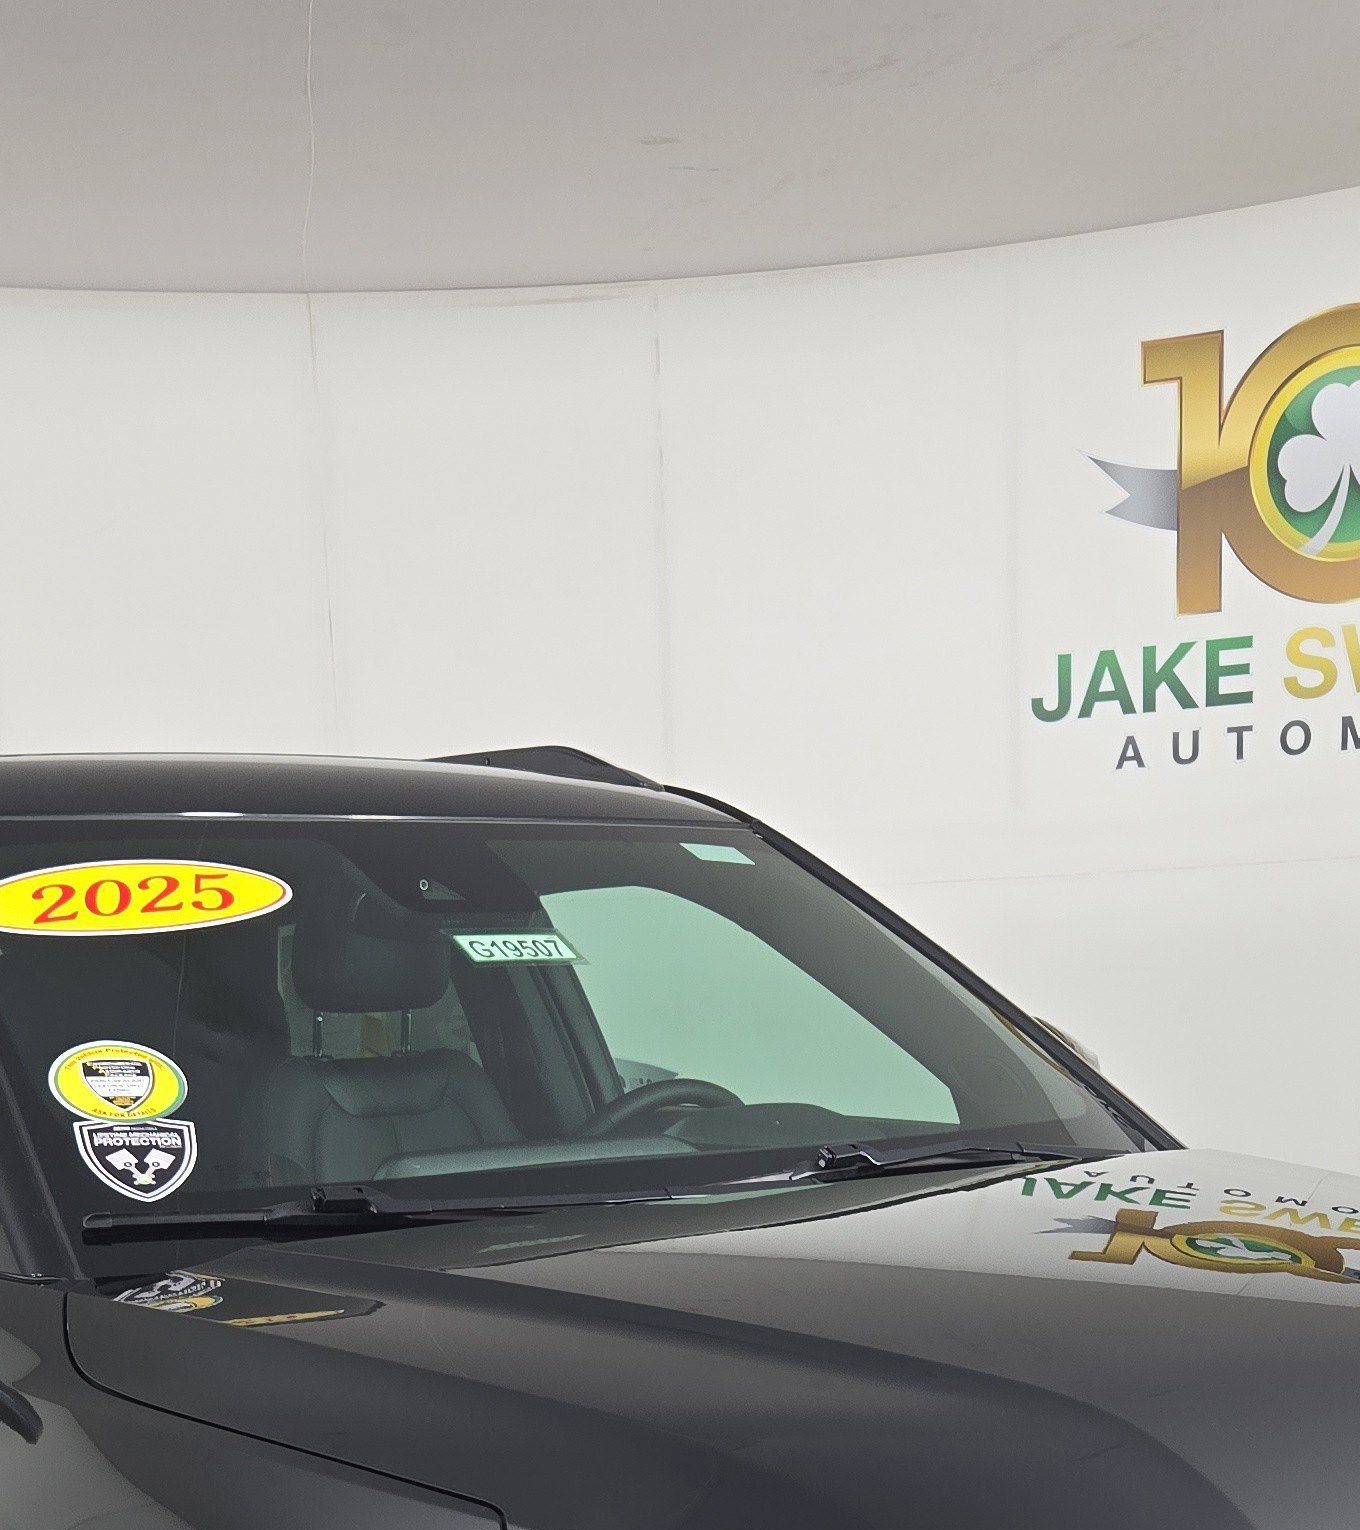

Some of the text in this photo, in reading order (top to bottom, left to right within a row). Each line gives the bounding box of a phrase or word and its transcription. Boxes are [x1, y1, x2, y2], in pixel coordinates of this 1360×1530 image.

[1031, 635, 1255, 723] JAKE
[31, 873, 235, 925] 2025
[468, 939, 564, 958] G19507
[93, 1137, 182, 1147] PROTECTION
